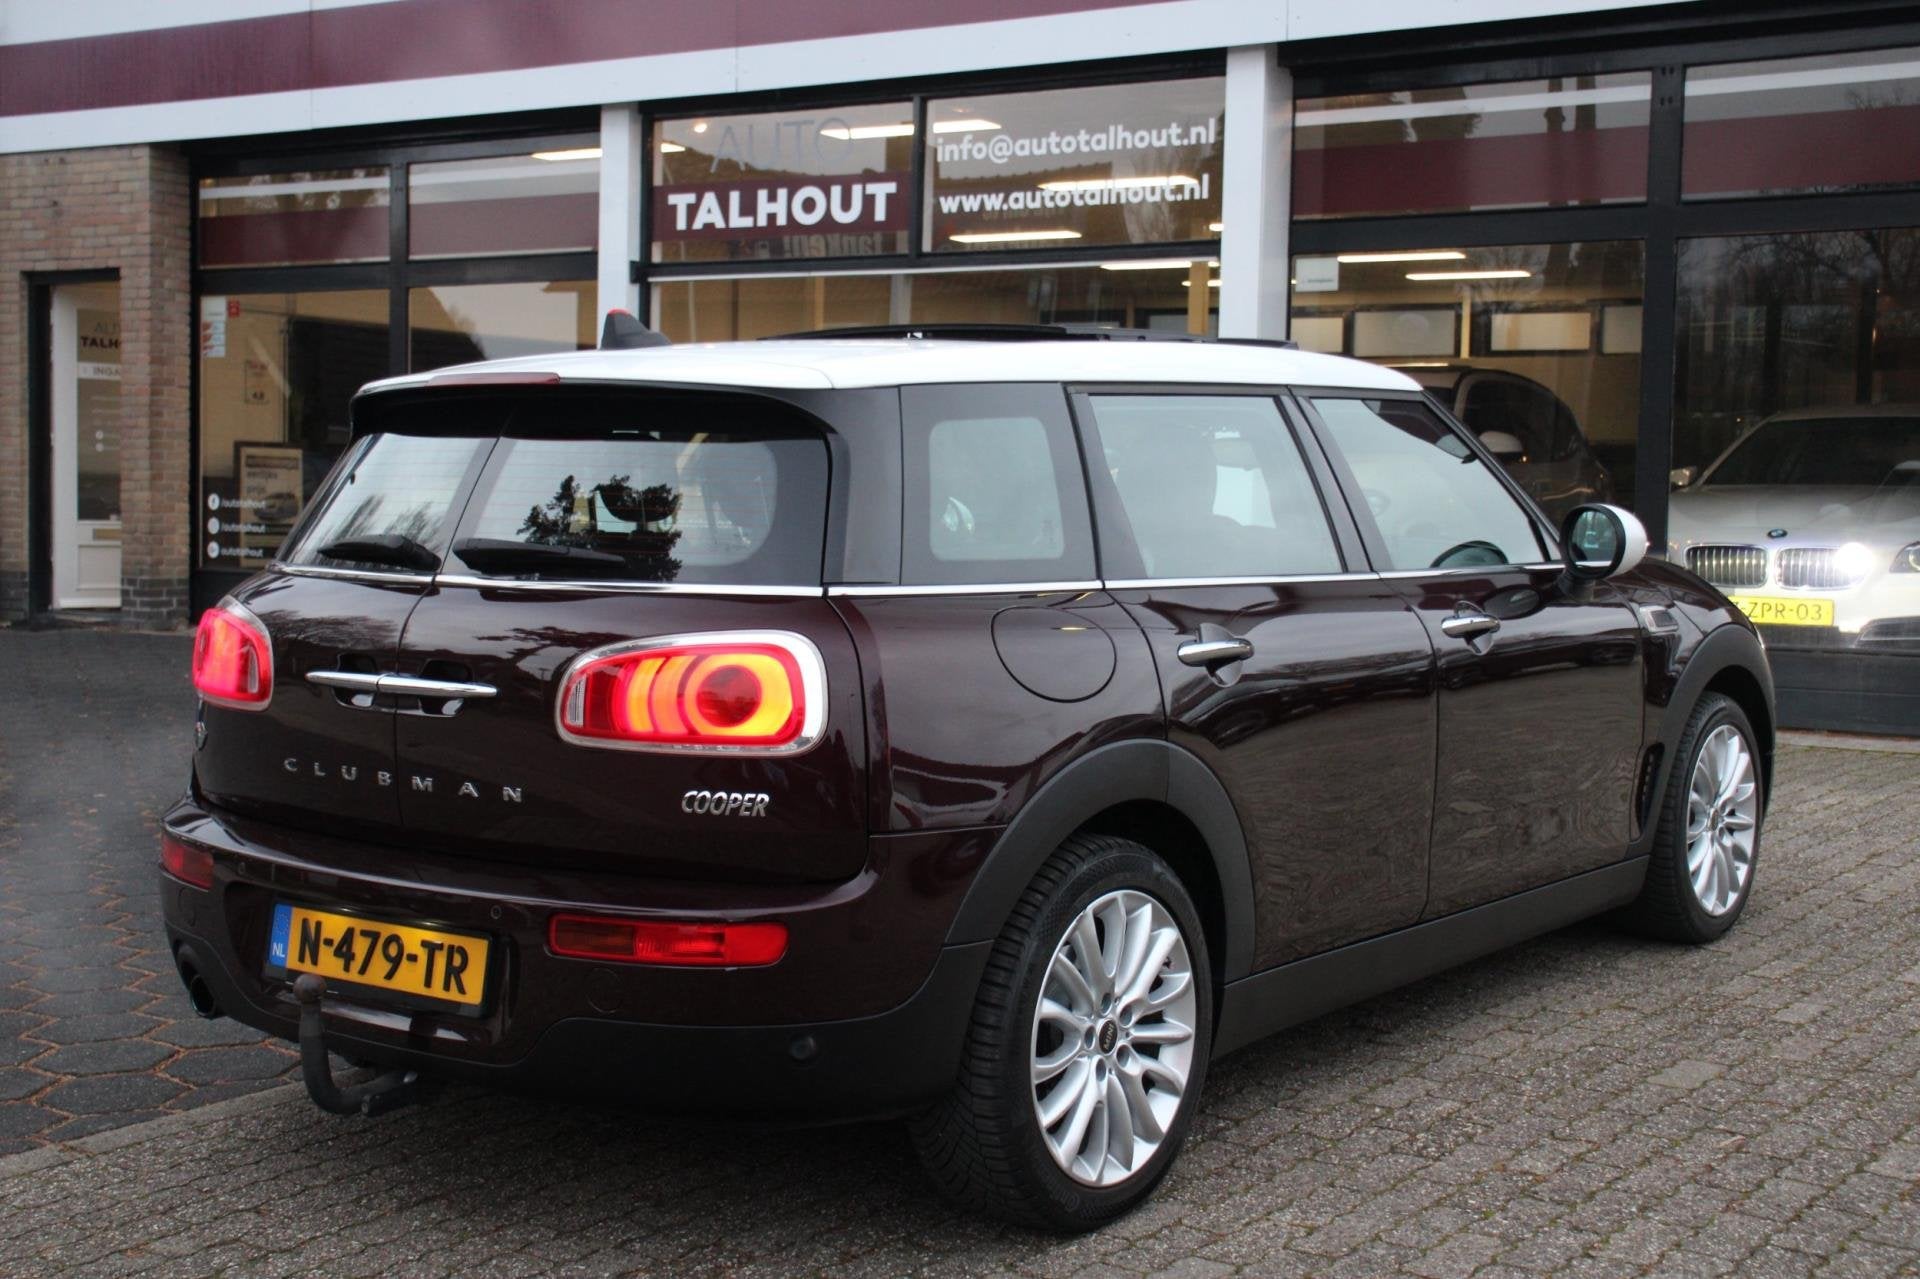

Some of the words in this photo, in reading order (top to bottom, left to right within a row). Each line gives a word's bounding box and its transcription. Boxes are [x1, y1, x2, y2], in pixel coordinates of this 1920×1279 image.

[708, 116, 857, 175] AUTO
[936, 116, 1216, 165] info@autotalhout.nl
[668, 181, 898, 231] TALHOUT
[938, 172, 1210, 215] www.autotalhout.nl
[80, 335, 121, 349] TALH
[1734, 601, 1823, 621] -ZPR-03
[283, 757, 523, 804] CLUBMAN
[681, 789, 770, 819] COOPER
[271, 942, 286, 958] NL
[297, 917, 468, 996] N-479-TR
